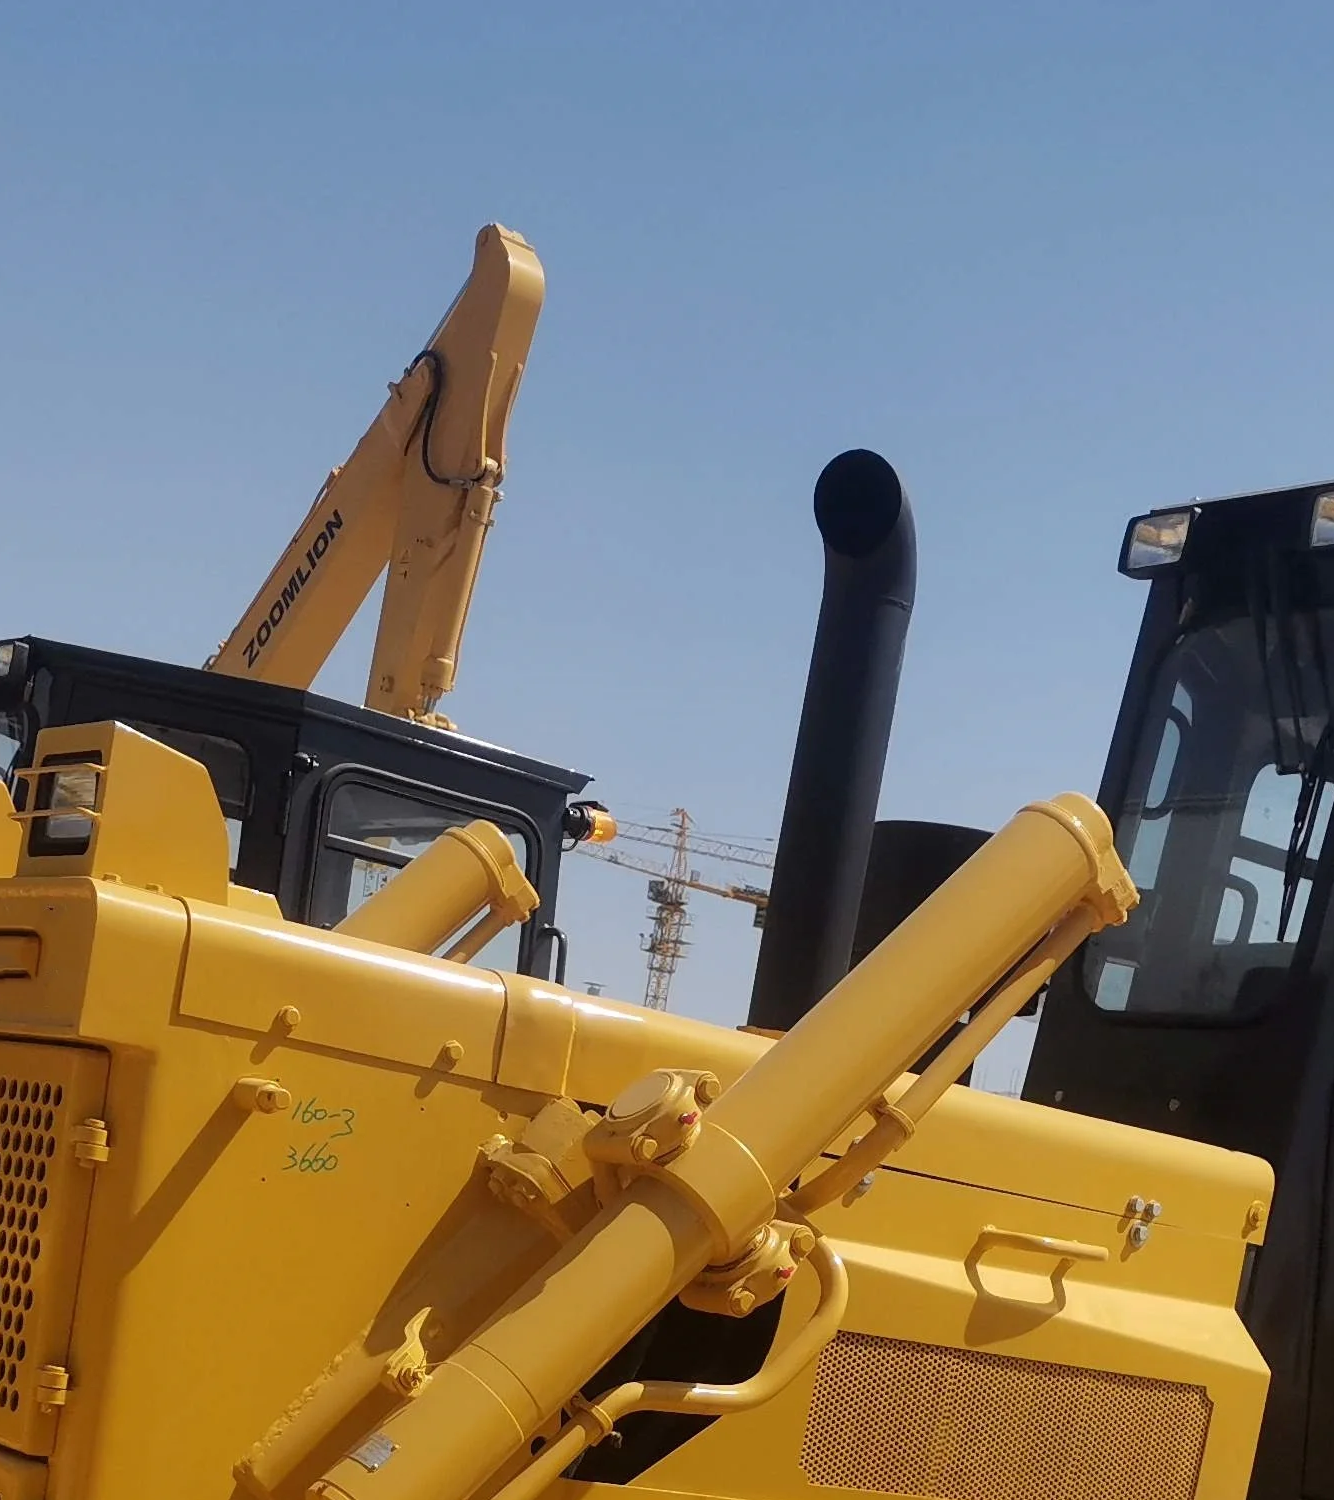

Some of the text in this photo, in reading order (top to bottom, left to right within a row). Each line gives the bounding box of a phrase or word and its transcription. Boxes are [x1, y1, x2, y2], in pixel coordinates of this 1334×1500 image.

[243, 510, 343, 668] ZOOMLION
[292, 1098, 354, 1138] 160-3
[282, 1143, 338, 1172] 3660
